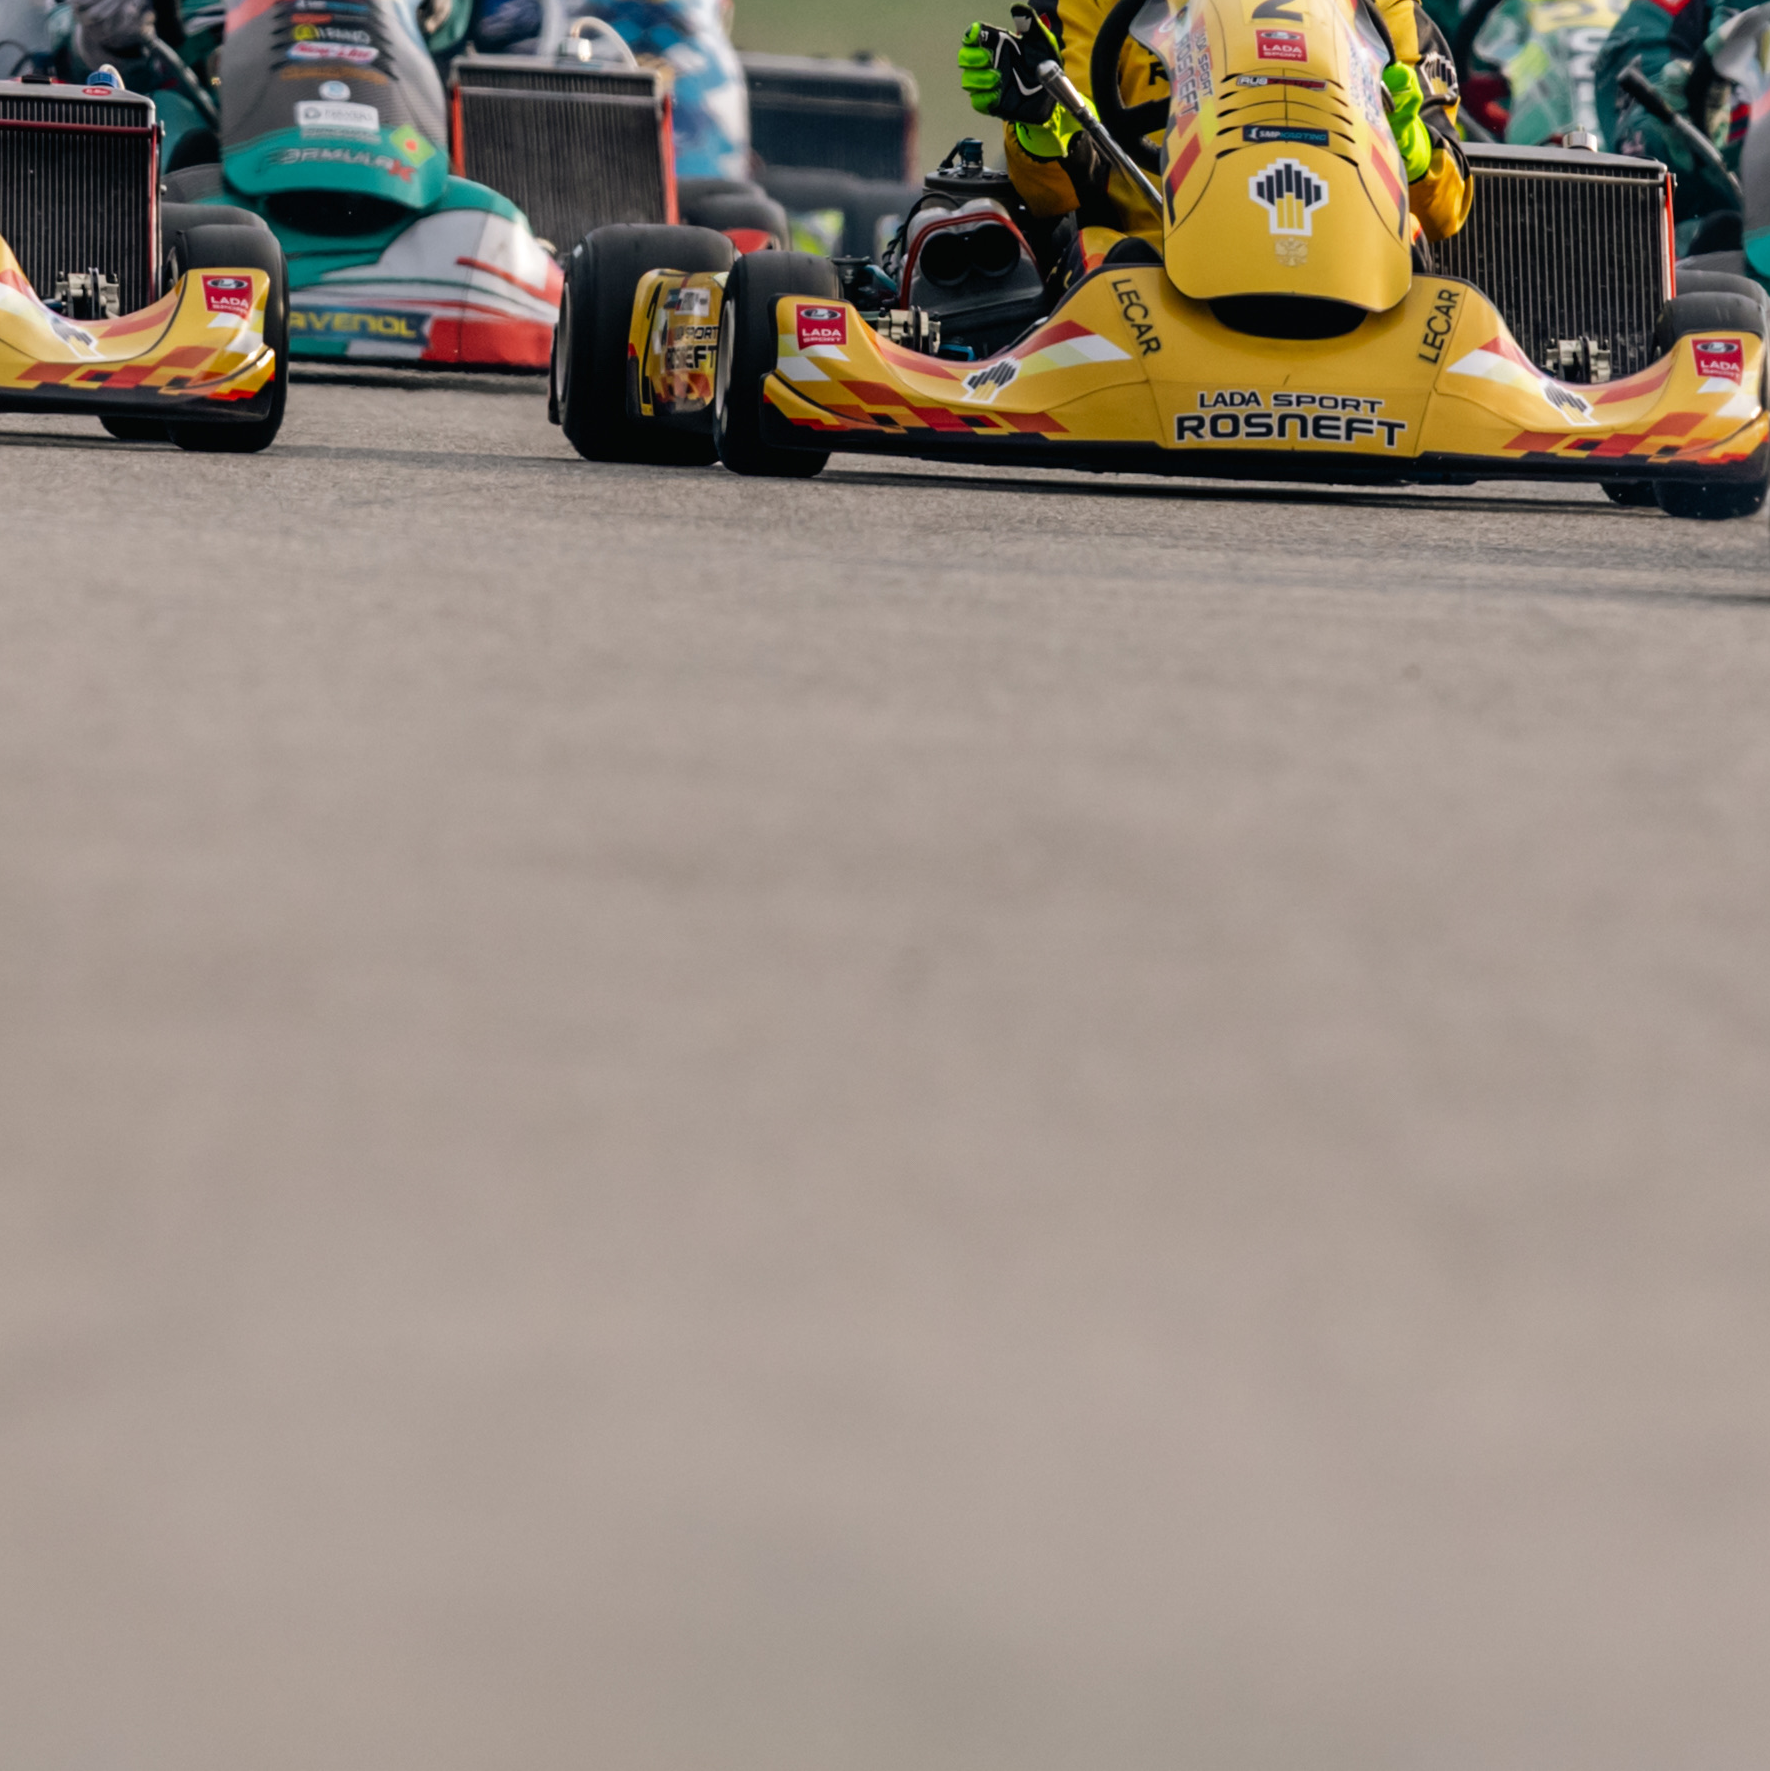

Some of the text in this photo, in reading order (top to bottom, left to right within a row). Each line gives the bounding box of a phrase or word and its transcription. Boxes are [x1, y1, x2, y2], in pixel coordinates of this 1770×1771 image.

[1262, 44, 1303, 54] LADA
[210, 295, 250, 309] LADA
[289, 310, 417, 339] AVENOL
[1112, 277, 1163, 357] LECAR
[1417, 288, 1460, 366] LECAR
[801, 327, 842, 338] LADA
[1700, 359, 1741, 372] LADA
[1199, 391, 1384, 414] LADA SPORT
[1175, 412, 1407, 448] ROSNEFT
